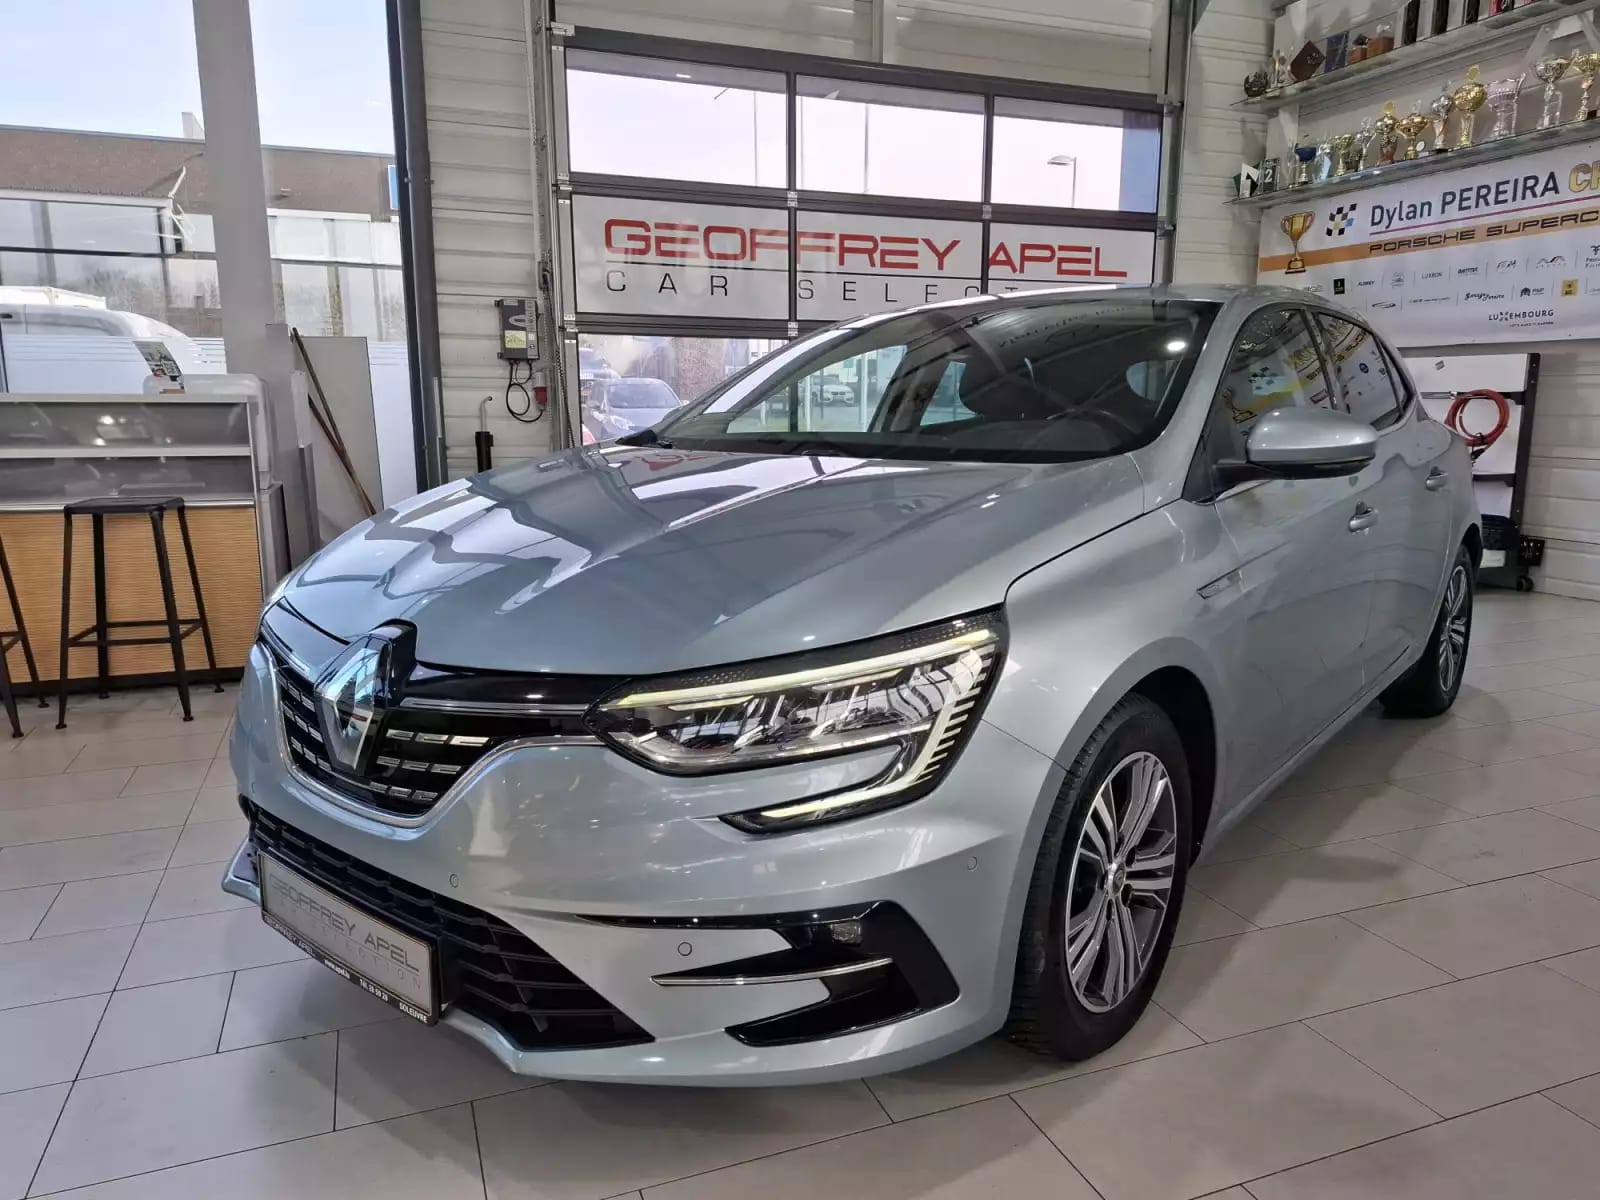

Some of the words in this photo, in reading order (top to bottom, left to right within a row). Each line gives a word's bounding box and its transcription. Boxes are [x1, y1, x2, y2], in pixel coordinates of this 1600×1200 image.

[1264, 168, 1273, 183] 2
[1370, 200, 1433, 229] Dylan
[1440, 171, 1560, 215] PEREIRA
[604, 218, 961, 271] GEOFFREY
[988, 241, 1128, 278] APEL
[1368, 228, 1476, 254] PORSCHE
[1486, 209, 1600, 237] SUPERC
[606, 270, 728, 296] CAR
[1488, 309, 1554, 321] LUXEMBOURG
[364, 932, 420, 973] APEL
[399, 1001, 428, 1024] SOLEUVRE
